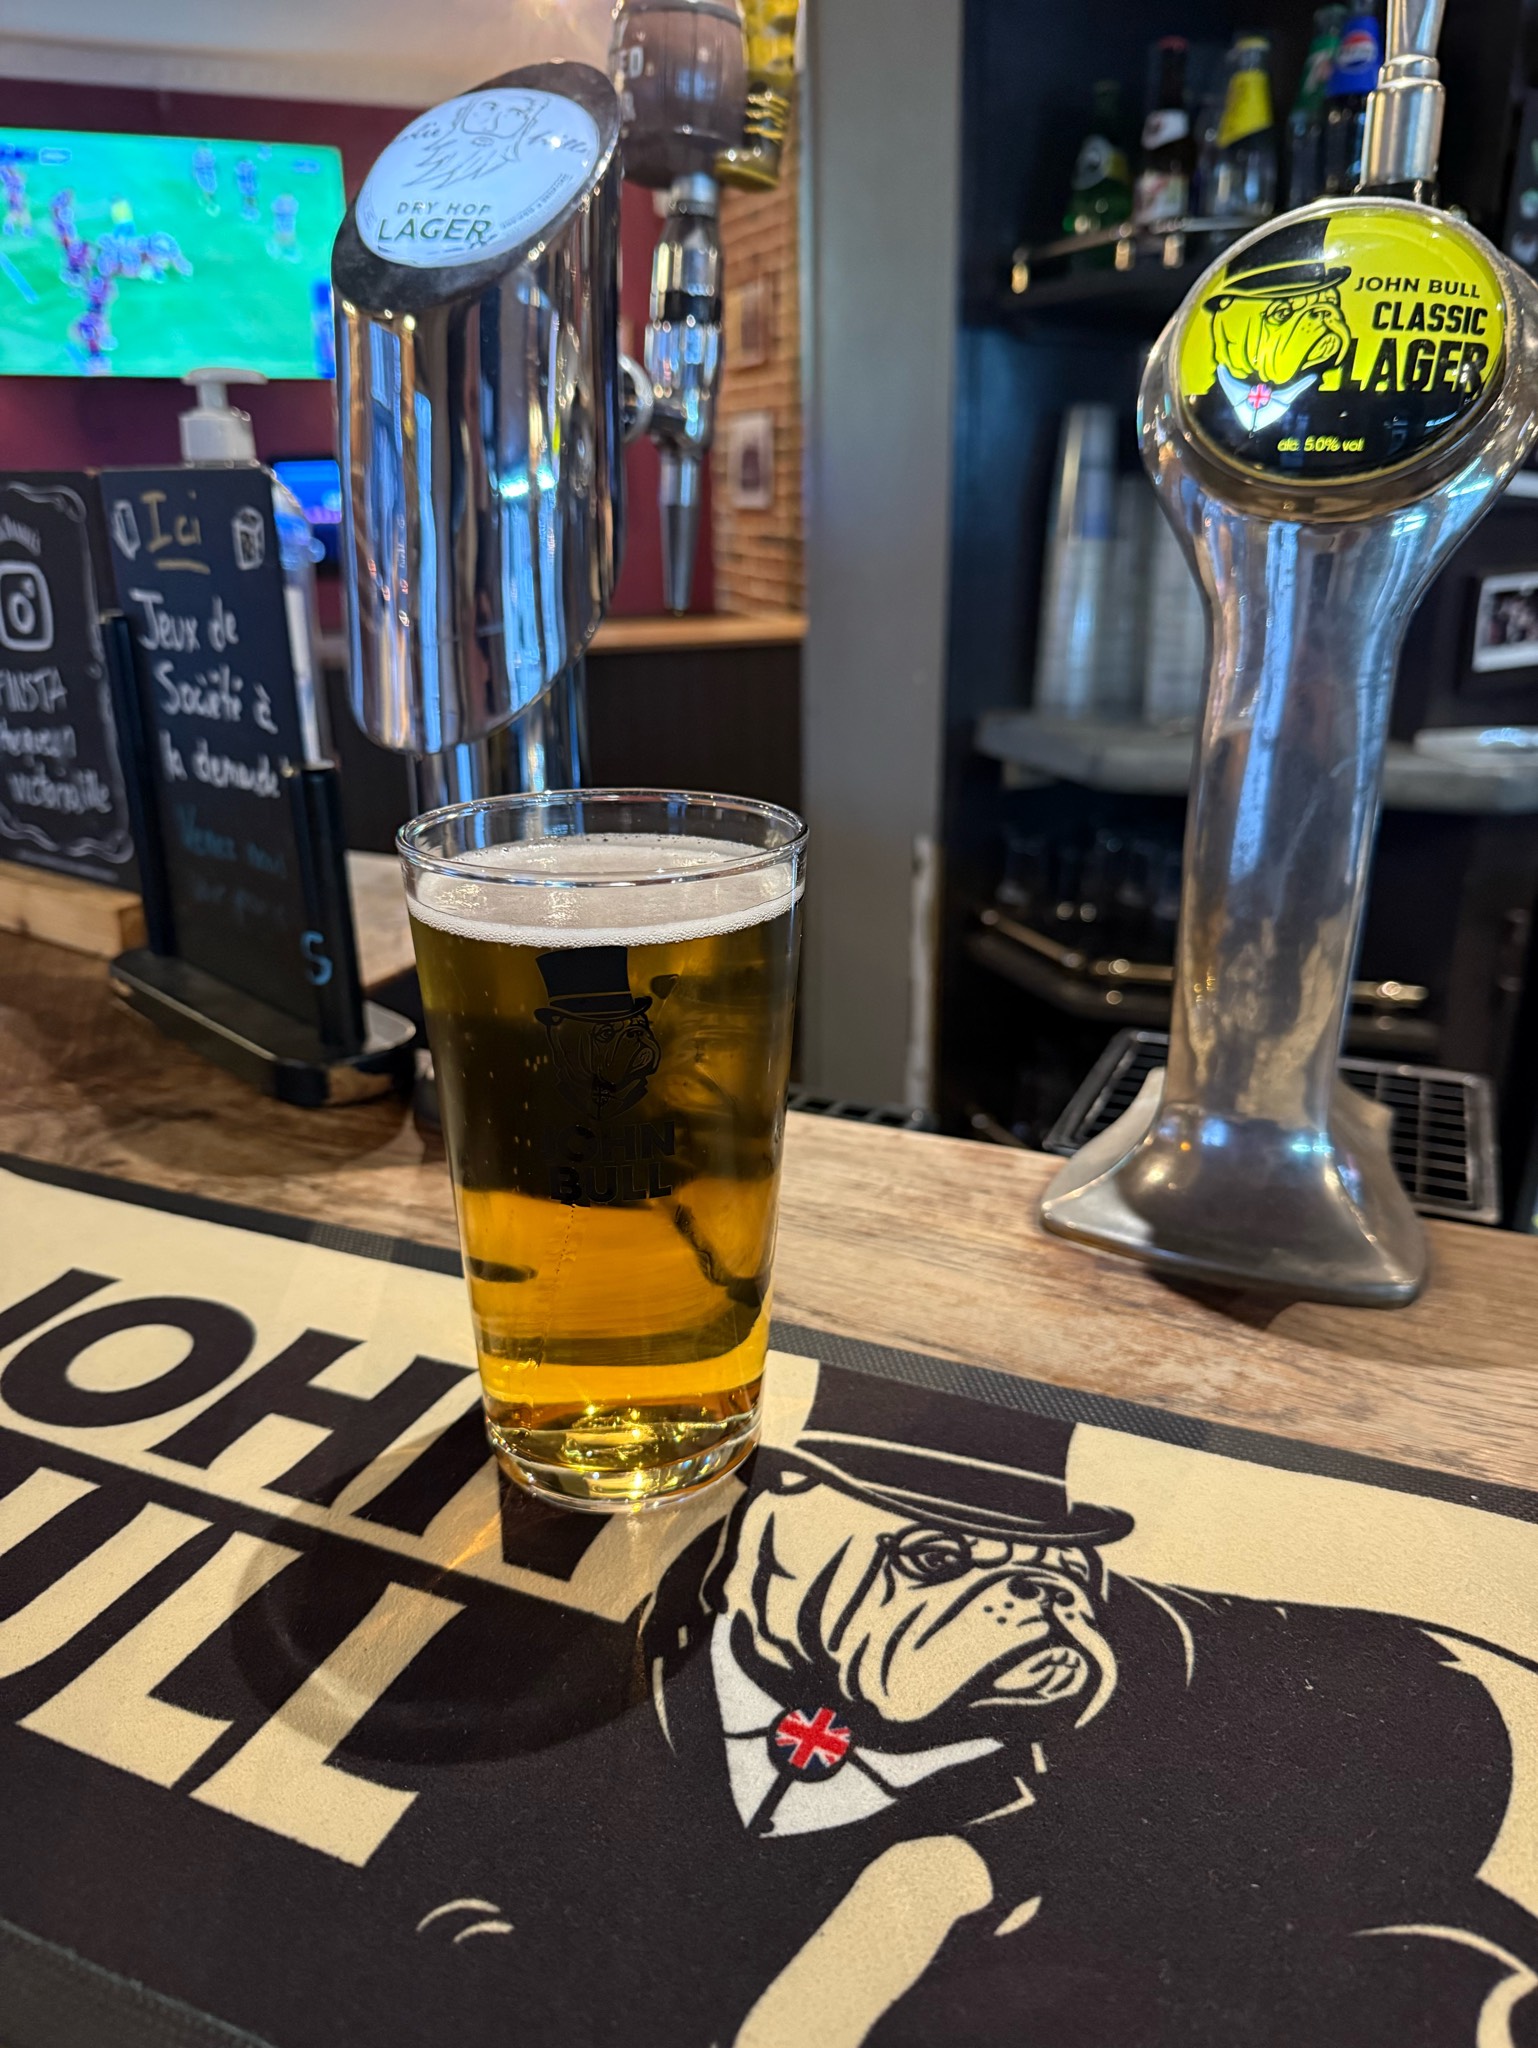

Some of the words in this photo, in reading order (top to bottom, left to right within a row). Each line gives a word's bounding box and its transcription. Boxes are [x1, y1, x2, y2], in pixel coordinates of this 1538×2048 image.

[397, 201, 439, 215] DRY
[378, 218, 493, 242] LAGER
[1354, 276, 1420, 293] JOHN
[1427, 279, 1481, 299] BULL
[1372, 301, 1488, 336] CLASSIC
[1338, 337, 1490, 393] LAGER
[1342, 437, 1366, 452] vol
[129, 587, 200, 652] Jeux
[208, 595, 239, 652] de
[549, 1161, 673, 1205] BULL
[0, 1465, 465, 1868] ULL
